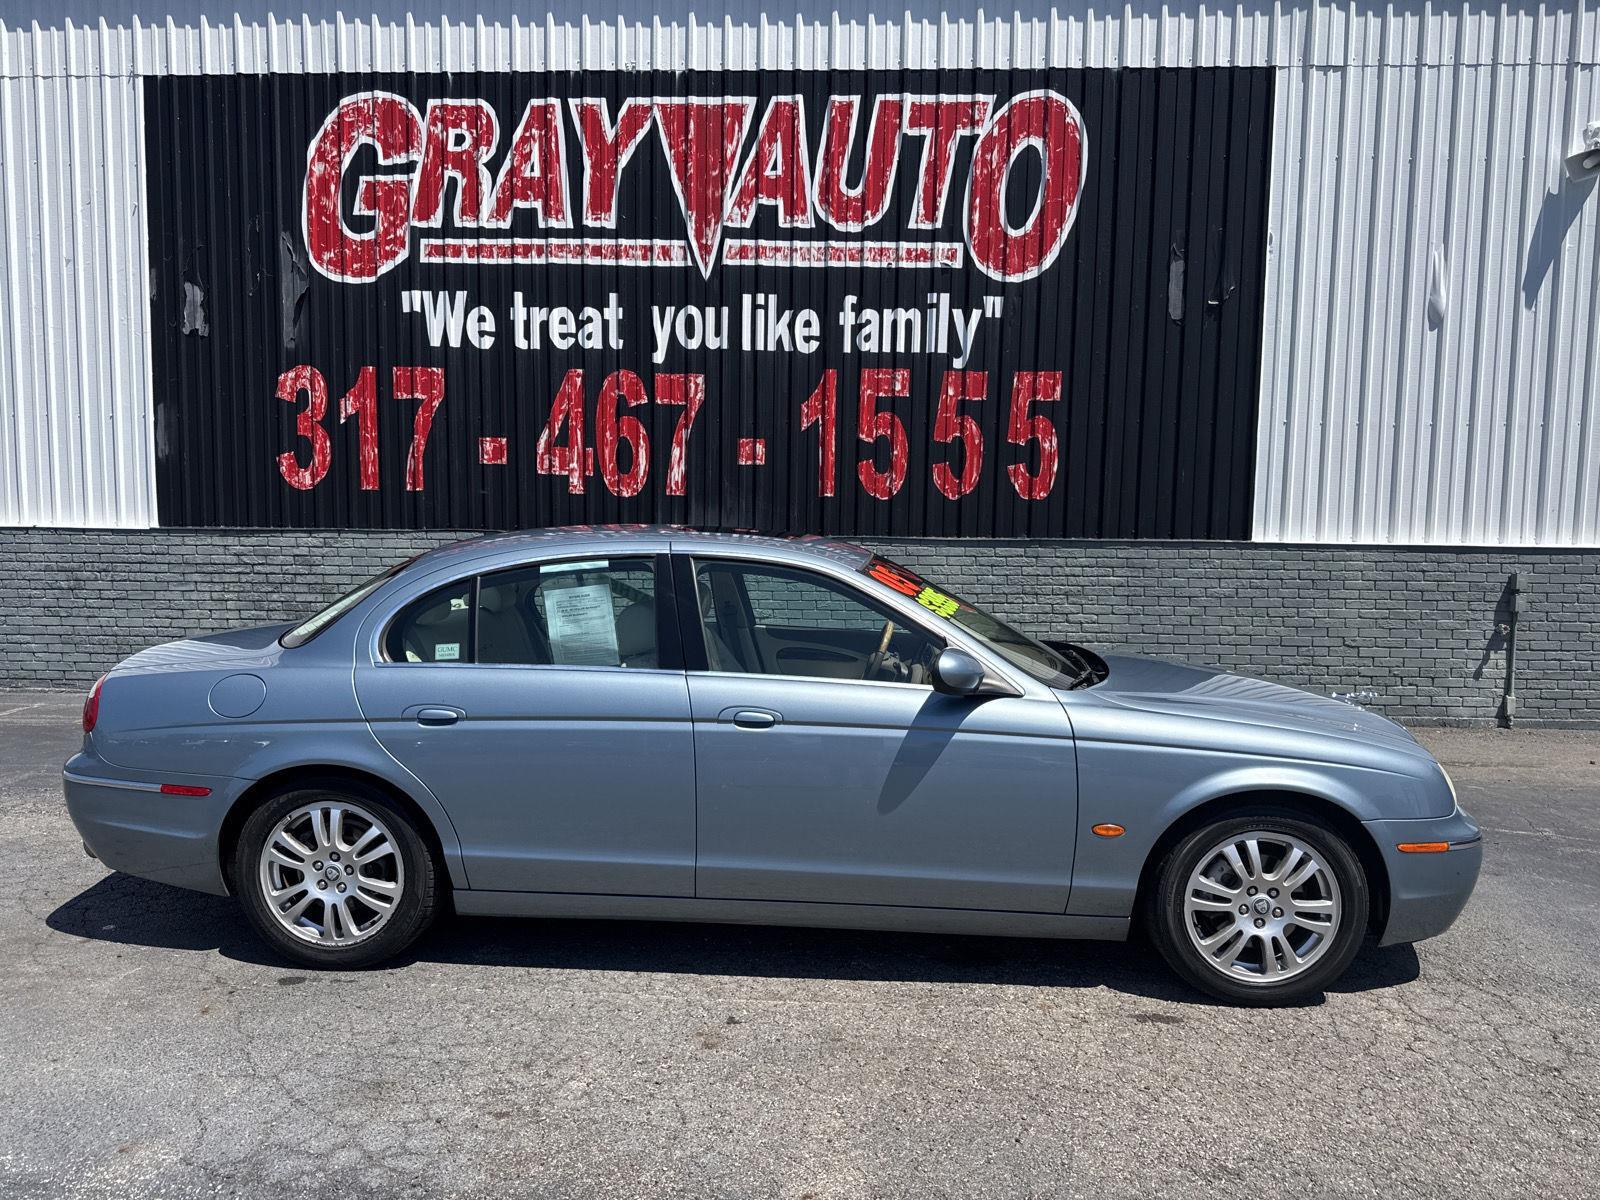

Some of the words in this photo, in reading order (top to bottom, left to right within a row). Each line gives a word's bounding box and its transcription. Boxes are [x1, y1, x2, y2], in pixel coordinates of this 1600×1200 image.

[302, 90, 656, 284] GRAY
[722, 89, 1089, 283] AUTO
[401, 289, 496, 350] "We
[510, 291, 624, 350] treat
[650, 304, 729, 364] you
[741, 293, 821, 354] like
[839, 292, 1004, 369] family"
[275, 364, 446, 491] 317
[536, 368, 706, 498] 467
[800, 368, 1063, 501] 1555
